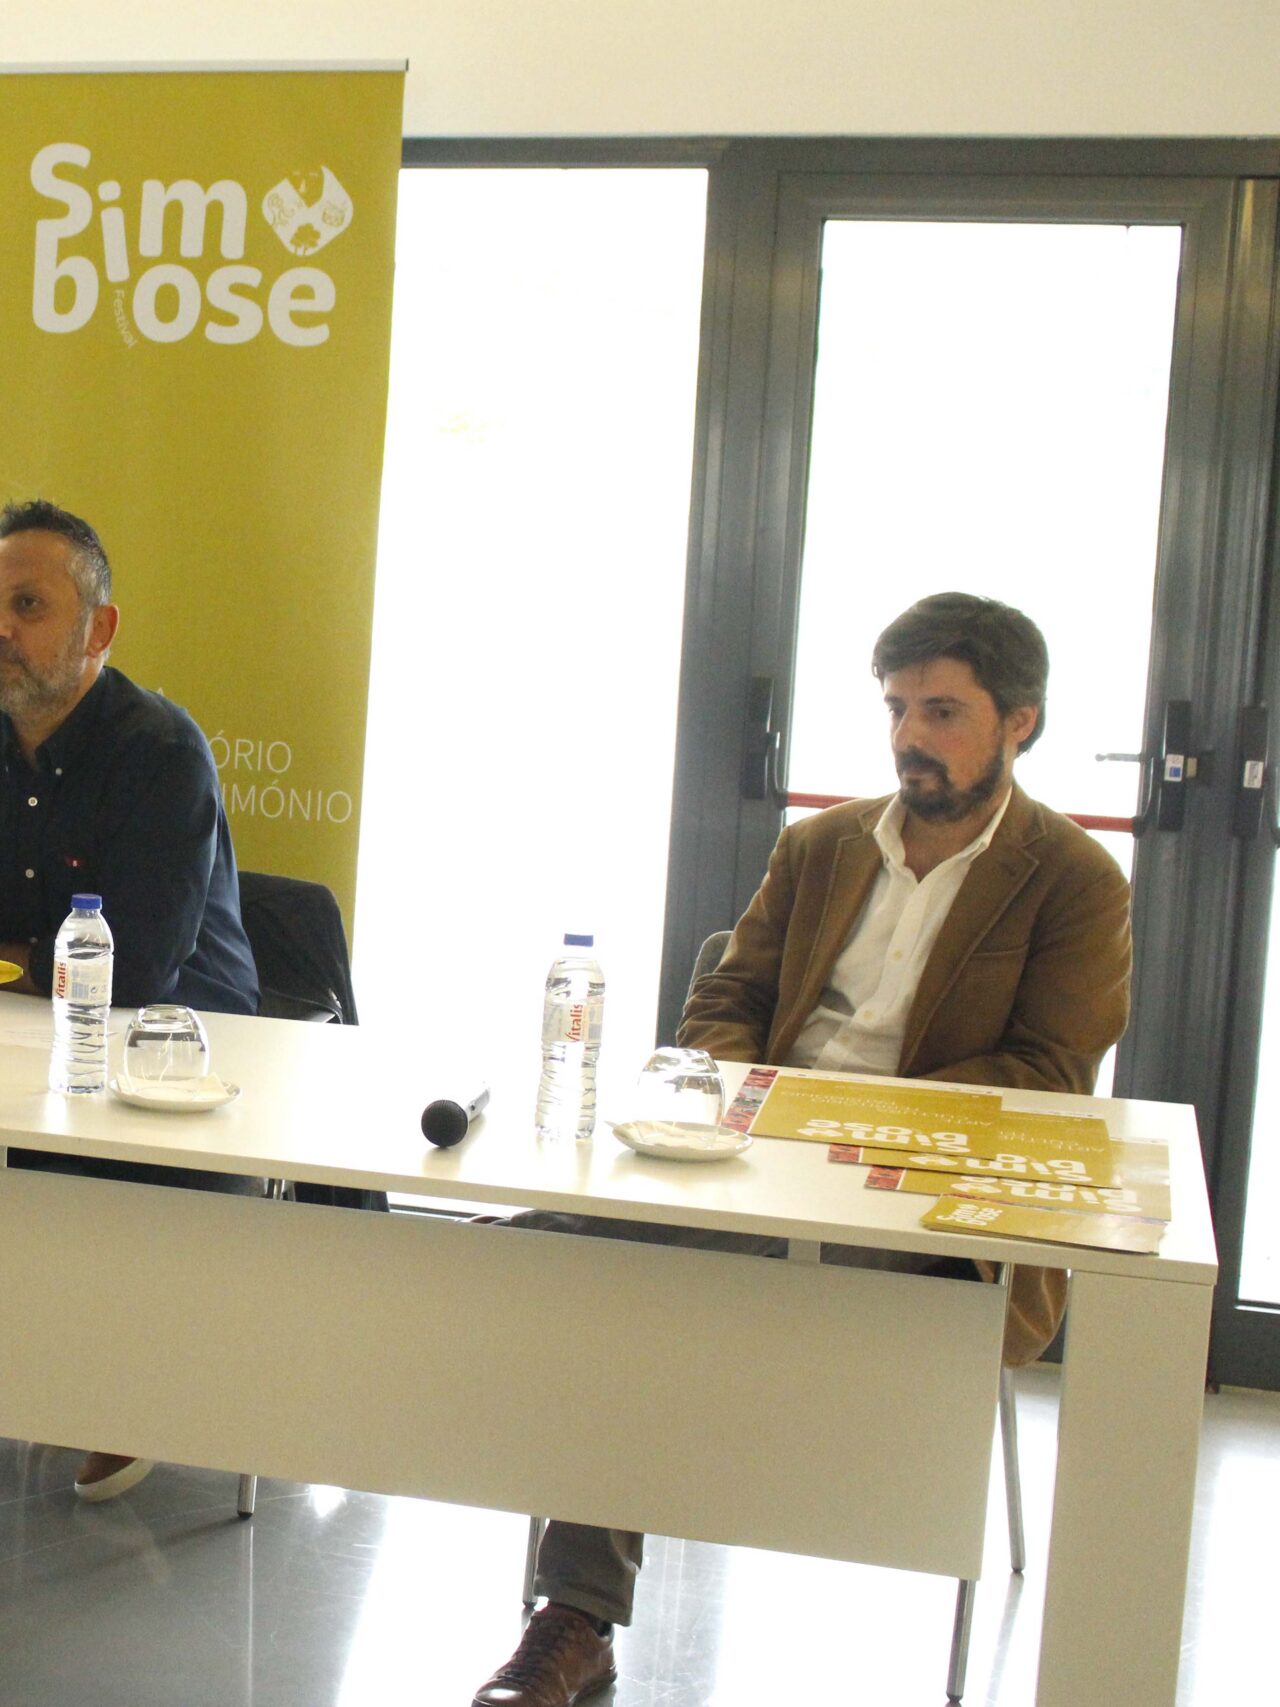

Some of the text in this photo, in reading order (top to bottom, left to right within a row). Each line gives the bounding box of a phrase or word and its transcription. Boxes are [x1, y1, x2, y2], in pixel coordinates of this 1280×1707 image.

[113, 288, 138, 349] Festival
[55, 961, 67, 999] Vitalis
[564, 1004, 583, 1042] Vitalis
